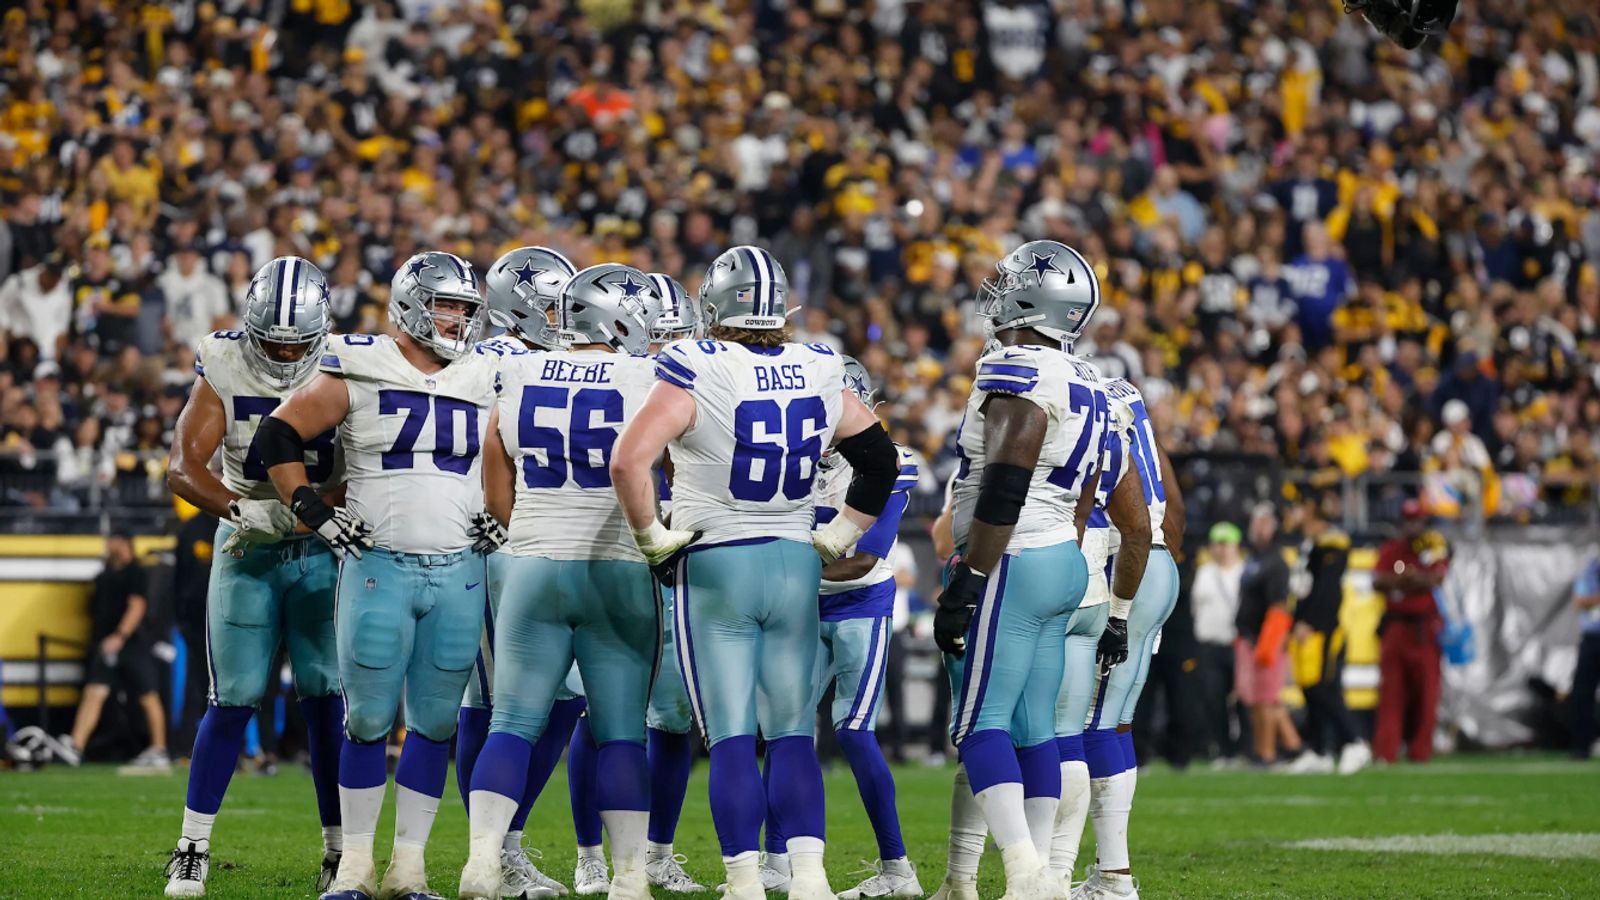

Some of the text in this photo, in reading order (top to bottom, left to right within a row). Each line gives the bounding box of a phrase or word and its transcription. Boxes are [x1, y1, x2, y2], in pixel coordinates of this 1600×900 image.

[541, 359, 613, 383] BEEBE
[754, 365, 806, 391] BASS
[378, 390, 480, 475] 70
[518, 386, 624, 489] 56
[728, 396, 828, 502] 66
